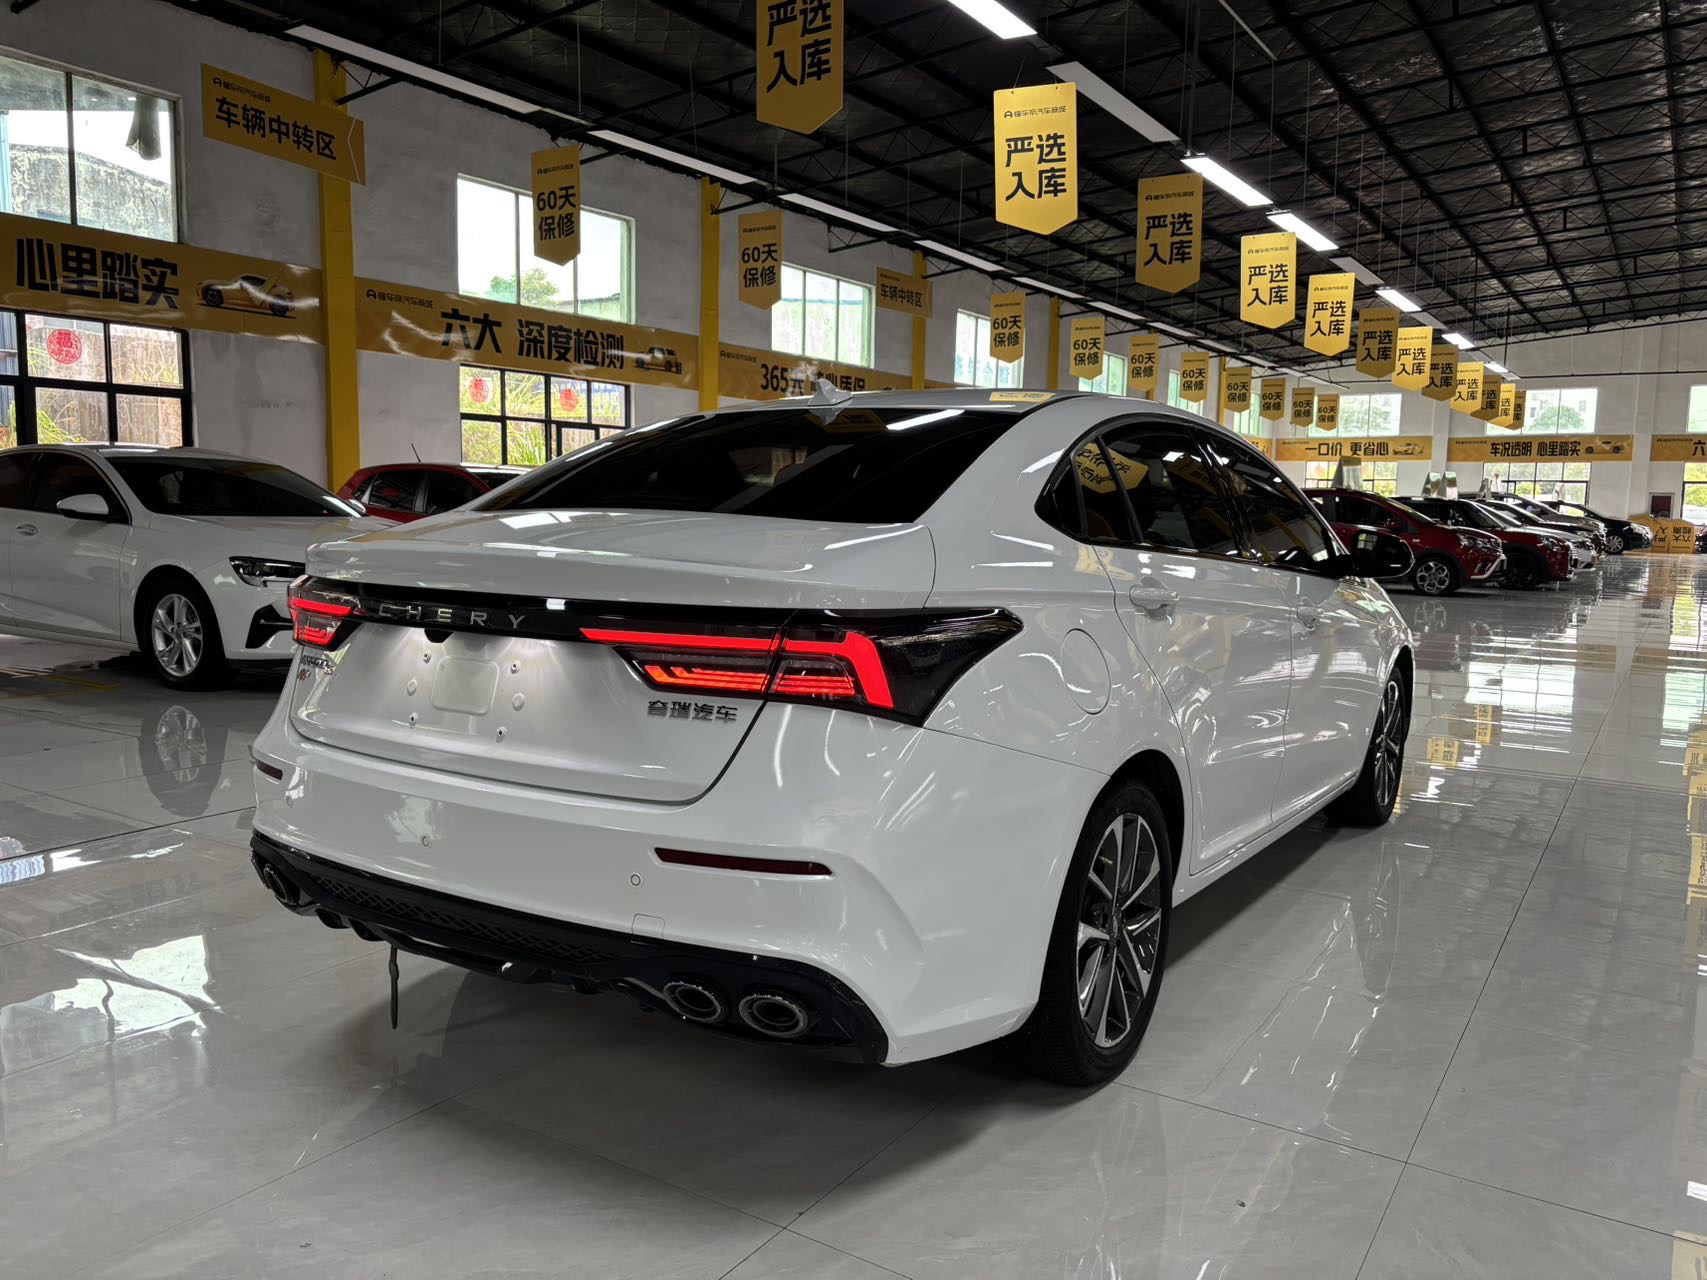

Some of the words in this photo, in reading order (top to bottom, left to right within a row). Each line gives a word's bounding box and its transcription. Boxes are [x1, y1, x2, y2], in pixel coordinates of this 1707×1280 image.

[766, 0, 832, 46] 严选
[767, 38, 832, 94] 入库
[215, 95, 337, 160] 车辆中转区
[1005, 132, 1067, 169] 严选
[1005, 166, 1067, 202] 入库
[536, 184, 577, 212] 60天
[538, 213, 575, 241] 保修
[1144, 212, 1194, 241] 严选
[741, 243, 778, 264] 60天
[1143, 239, 1193, 267] 入库
[15, 236, 180, 310] 心里踏实
[742, 265, 777, 289] 保修
[1247, 263, 1289, 286] 严选
[879, 283, 923, 308] 车辆中转区
[1247, 285, 1289, 307] 入库
[1311, 300, 1347, 320] 严选
[992, 314, 1022, 331] 60天
[1310, 319, 1346, 337] 入库
[440, 307, 502, 354] 六大
[516, 318, 625, 370] 深度检测
[993, 331, 1020, 348] 保修
[1073, 337, 1101, 351] 60天
[1362, 329, 1393, 346] 严选
[1074, 352, 1100, 366] 保修
[1131, 352, 1156, 366] 60天
[1361, 345, 1392, 362] 入库
[1397, 347, 1426, 362] 严选
[1131, 365, 1154, 378] 保修
[1182, 368, 1206, 380] 60天
[1396, 361, 1426, 376] 入库
[1429, 362, 1454, 375] 严选
[760, 363, 804, 397] 365元
[1182, 380, 1205, 392] 保修
[1227, 381, 1249, 392] 60天
[1426, 375, 1453, 389] 入库
[1456, 377, 1479, 390] 严选
[1227, 392, 1248, 403] 保修
[1262, 391, 1283, 401] 60天
[1454, 389, 1479, 402] 入库
[1482, 388, 1497, 400] 选
[1262, 401, 1282, 412] 保修
[1293, 400, 1313, 410] 60天
[1293, 409, 1311, 418] 保修
[1318, 406, 1337, 415] 60天
[1481, 399, 1497, 411] 库
[1305, 442, 1343, 457] 一口价
[1350, 442, 1389, 457] 更省心
[1490, 441, 1533, 457] 车况透明
[1536, 441, 1581, 457] 心里踏实
[1691, 439, 1707, 457] 六
[378, 602, 527, 630] CHERY
[646, 698, 740, 724] 奇瑞汽车
